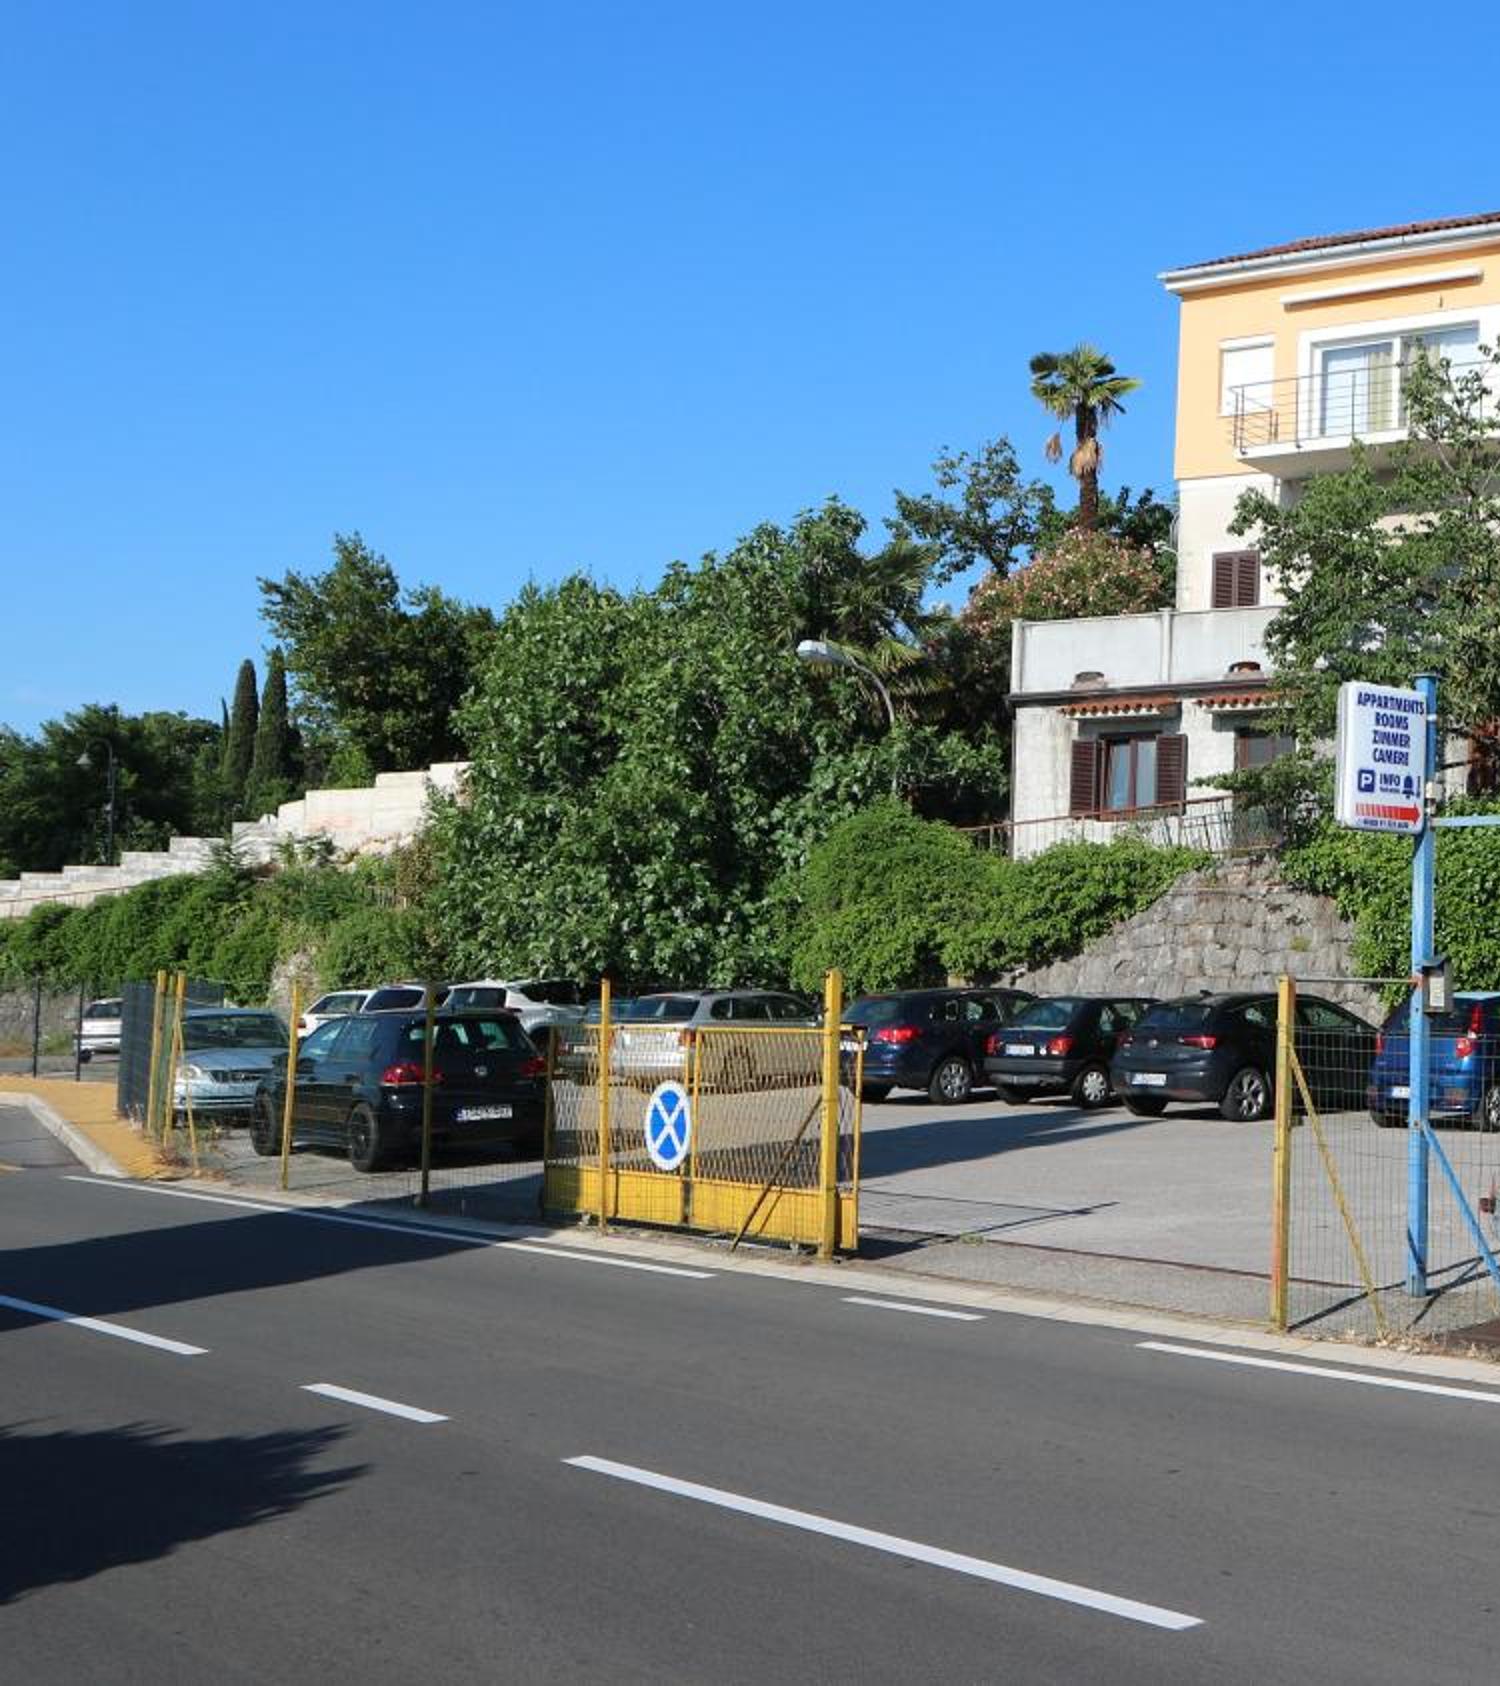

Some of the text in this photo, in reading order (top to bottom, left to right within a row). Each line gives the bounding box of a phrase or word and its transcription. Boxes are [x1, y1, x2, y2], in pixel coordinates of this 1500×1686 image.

[1357, 692, 1425, 715] APPARTMENTS
[1375, 712, 1409, 730] ROOMS
[1372, 729, 1411, 749] ZIMMER
[1373, 747, 1409, 767] CAMERE
[1379, 773, 1401, 787] INFO
